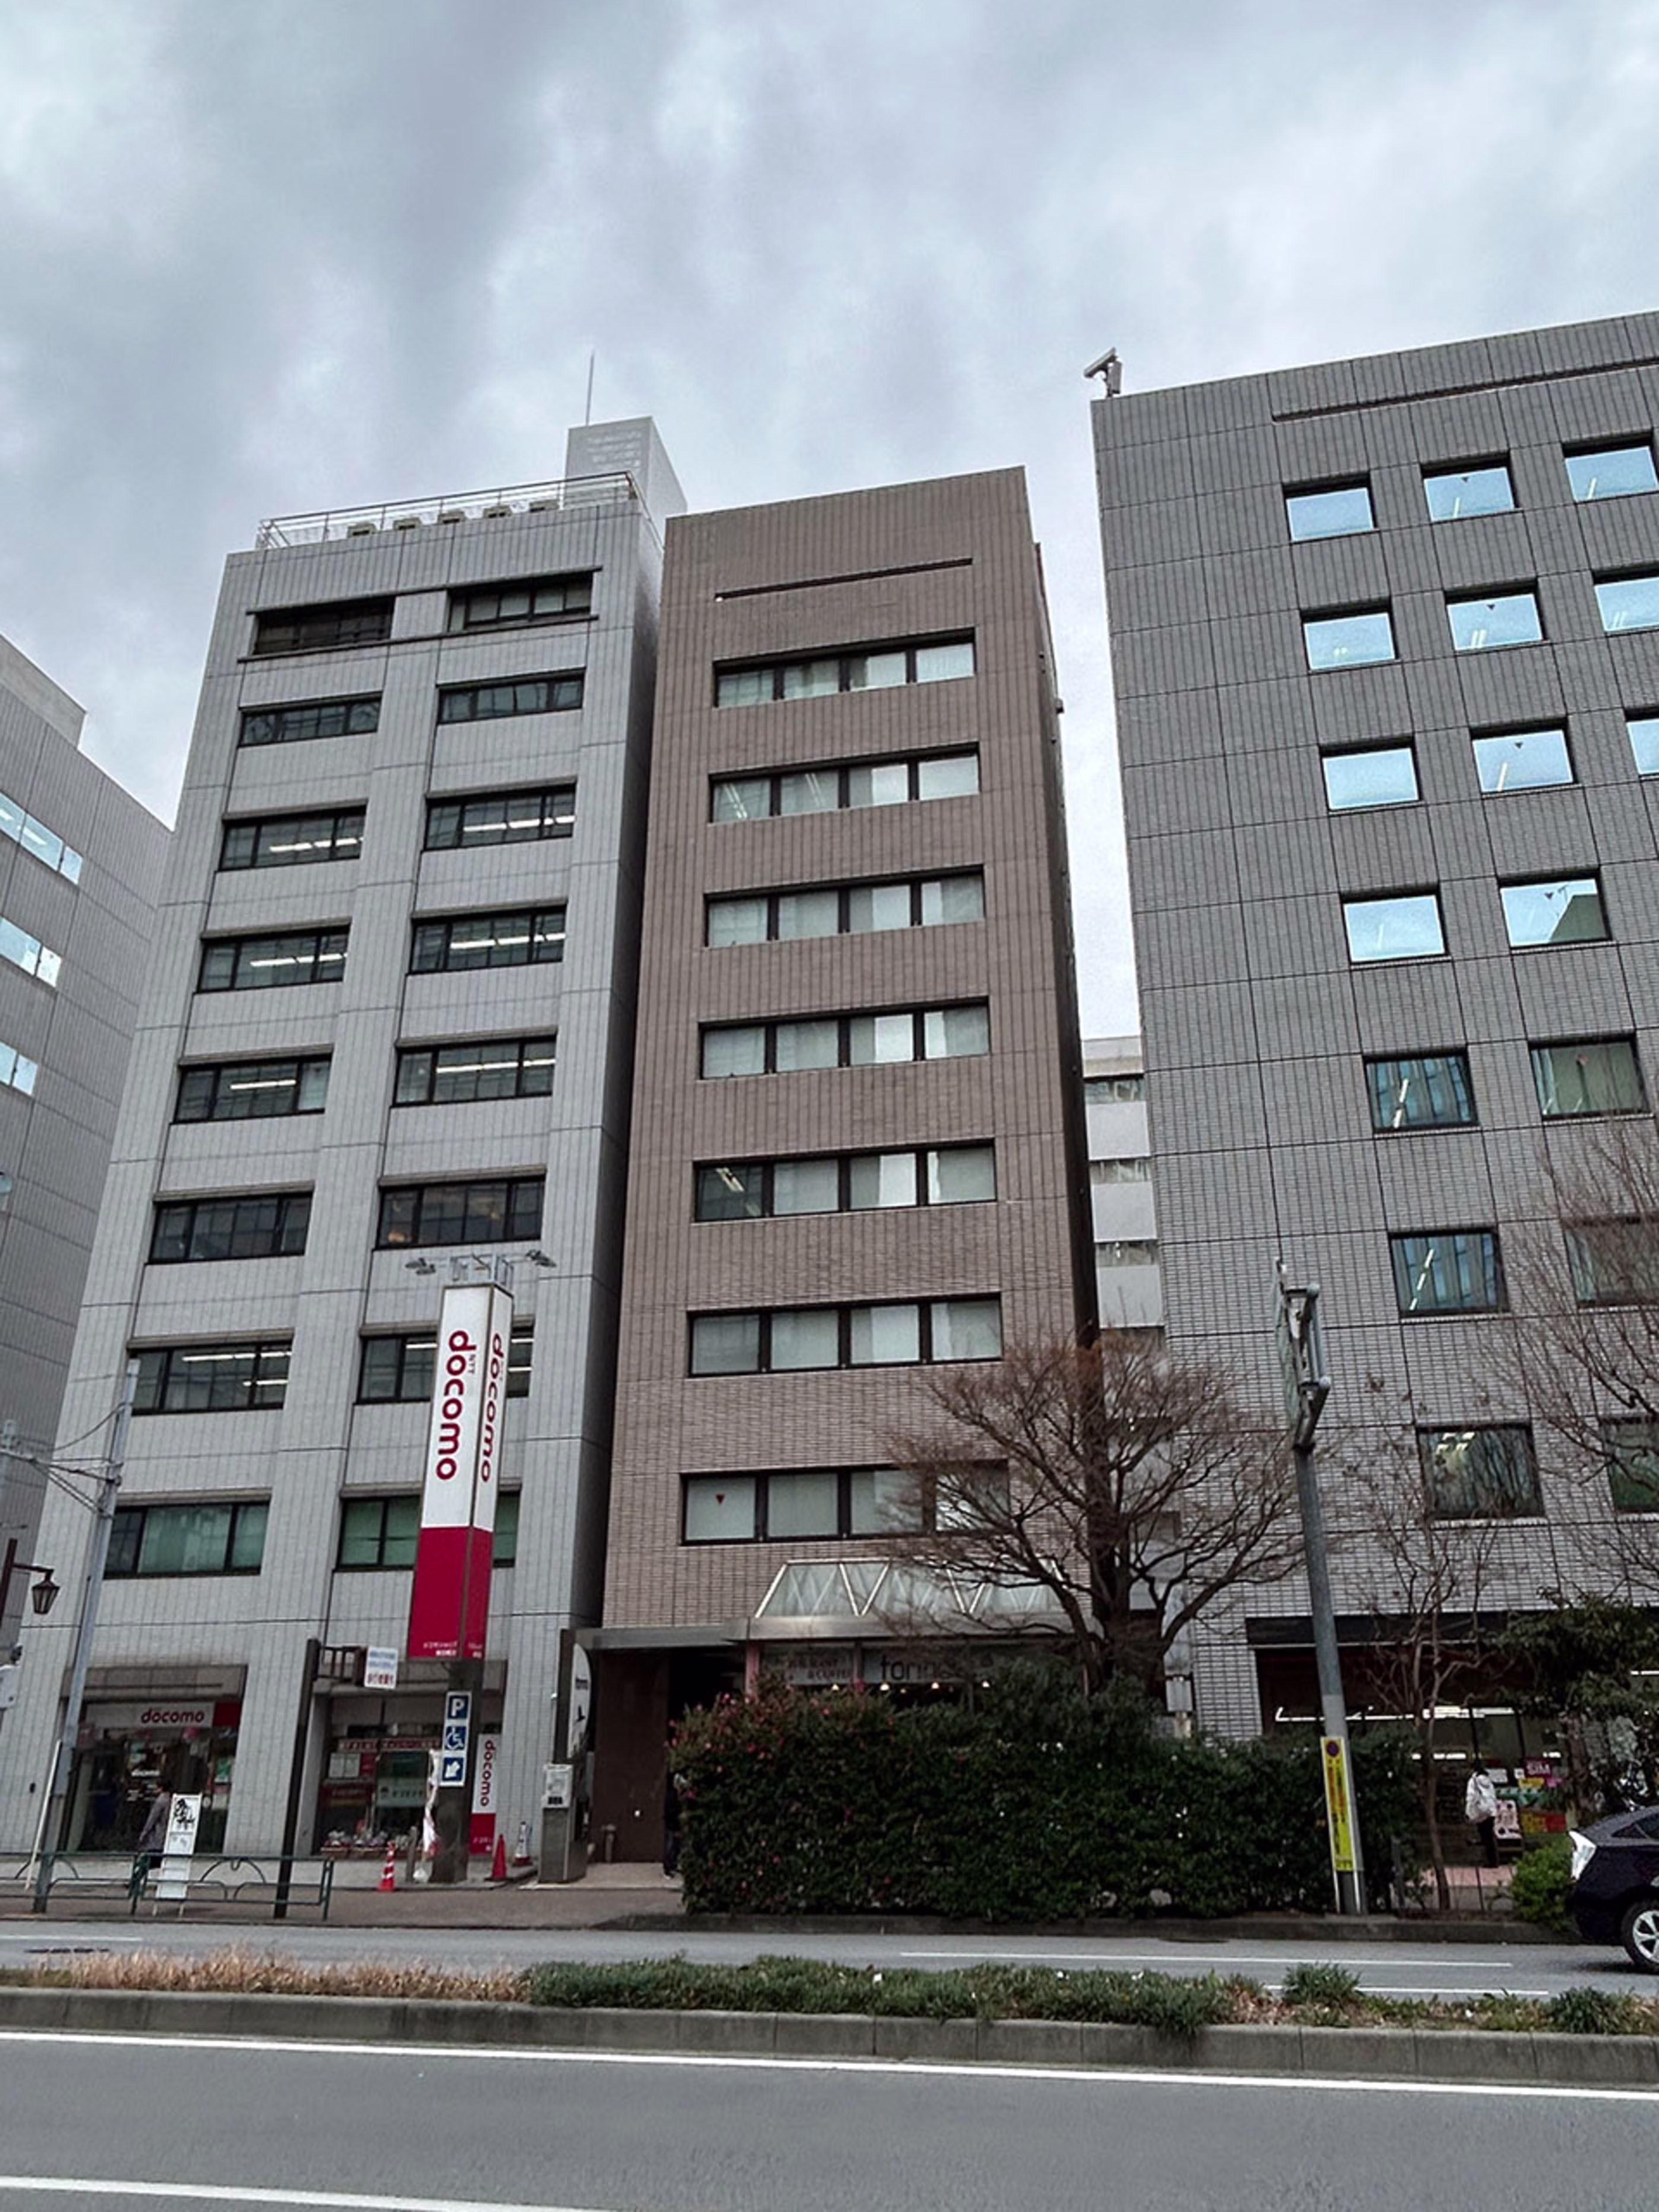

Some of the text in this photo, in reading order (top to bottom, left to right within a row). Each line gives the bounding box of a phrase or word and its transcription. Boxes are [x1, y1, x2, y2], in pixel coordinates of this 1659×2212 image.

[436, 1330, 477, 1480] docomo
[481, 1333, 504, 1482] docomo
[141, 1709, 204, 1723] docomo
[451, 1698, 464, 1716] P
[480, 1740, 496, 1807] docomo
